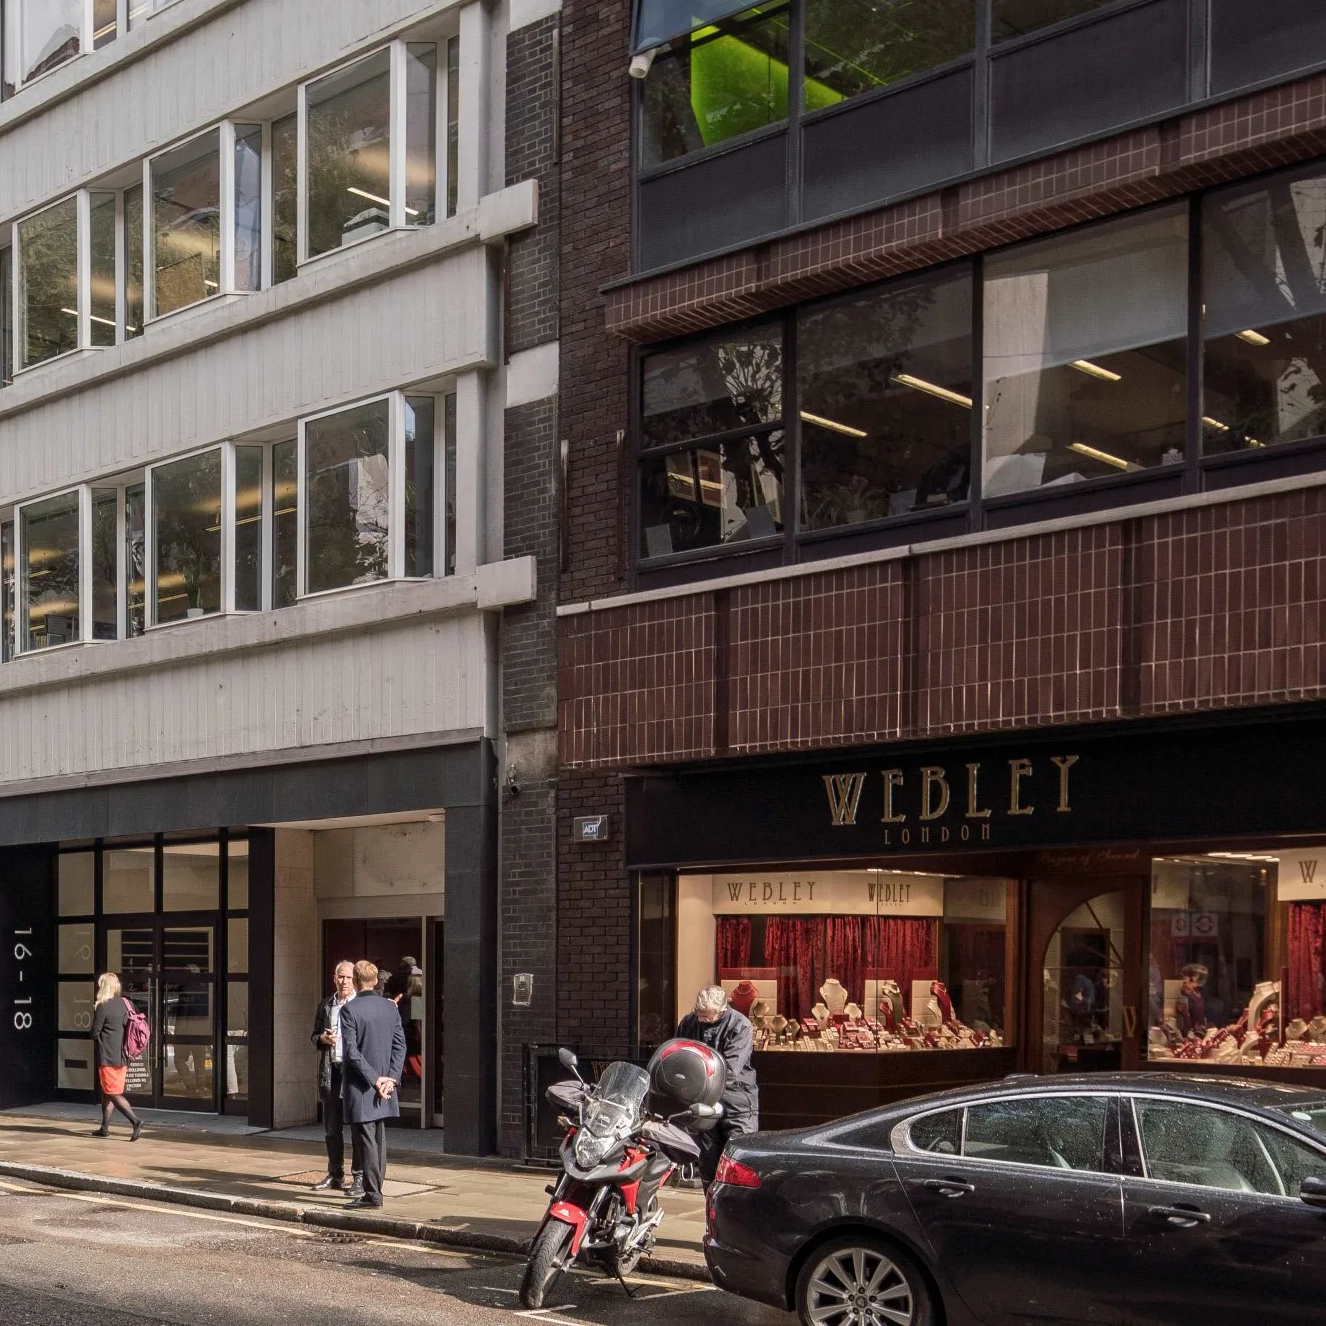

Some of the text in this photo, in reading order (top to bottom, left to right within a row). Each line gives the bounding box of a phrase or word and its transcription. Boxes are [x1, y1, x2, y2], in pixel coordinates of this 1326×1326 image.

[821, 754, 1079, 826] WEBLEY
[583, 824, 597, 834] ADT
[884, 823, 991, 845] LONDON
[727, 881, 911, 903] WEBLEY WEBLEY
